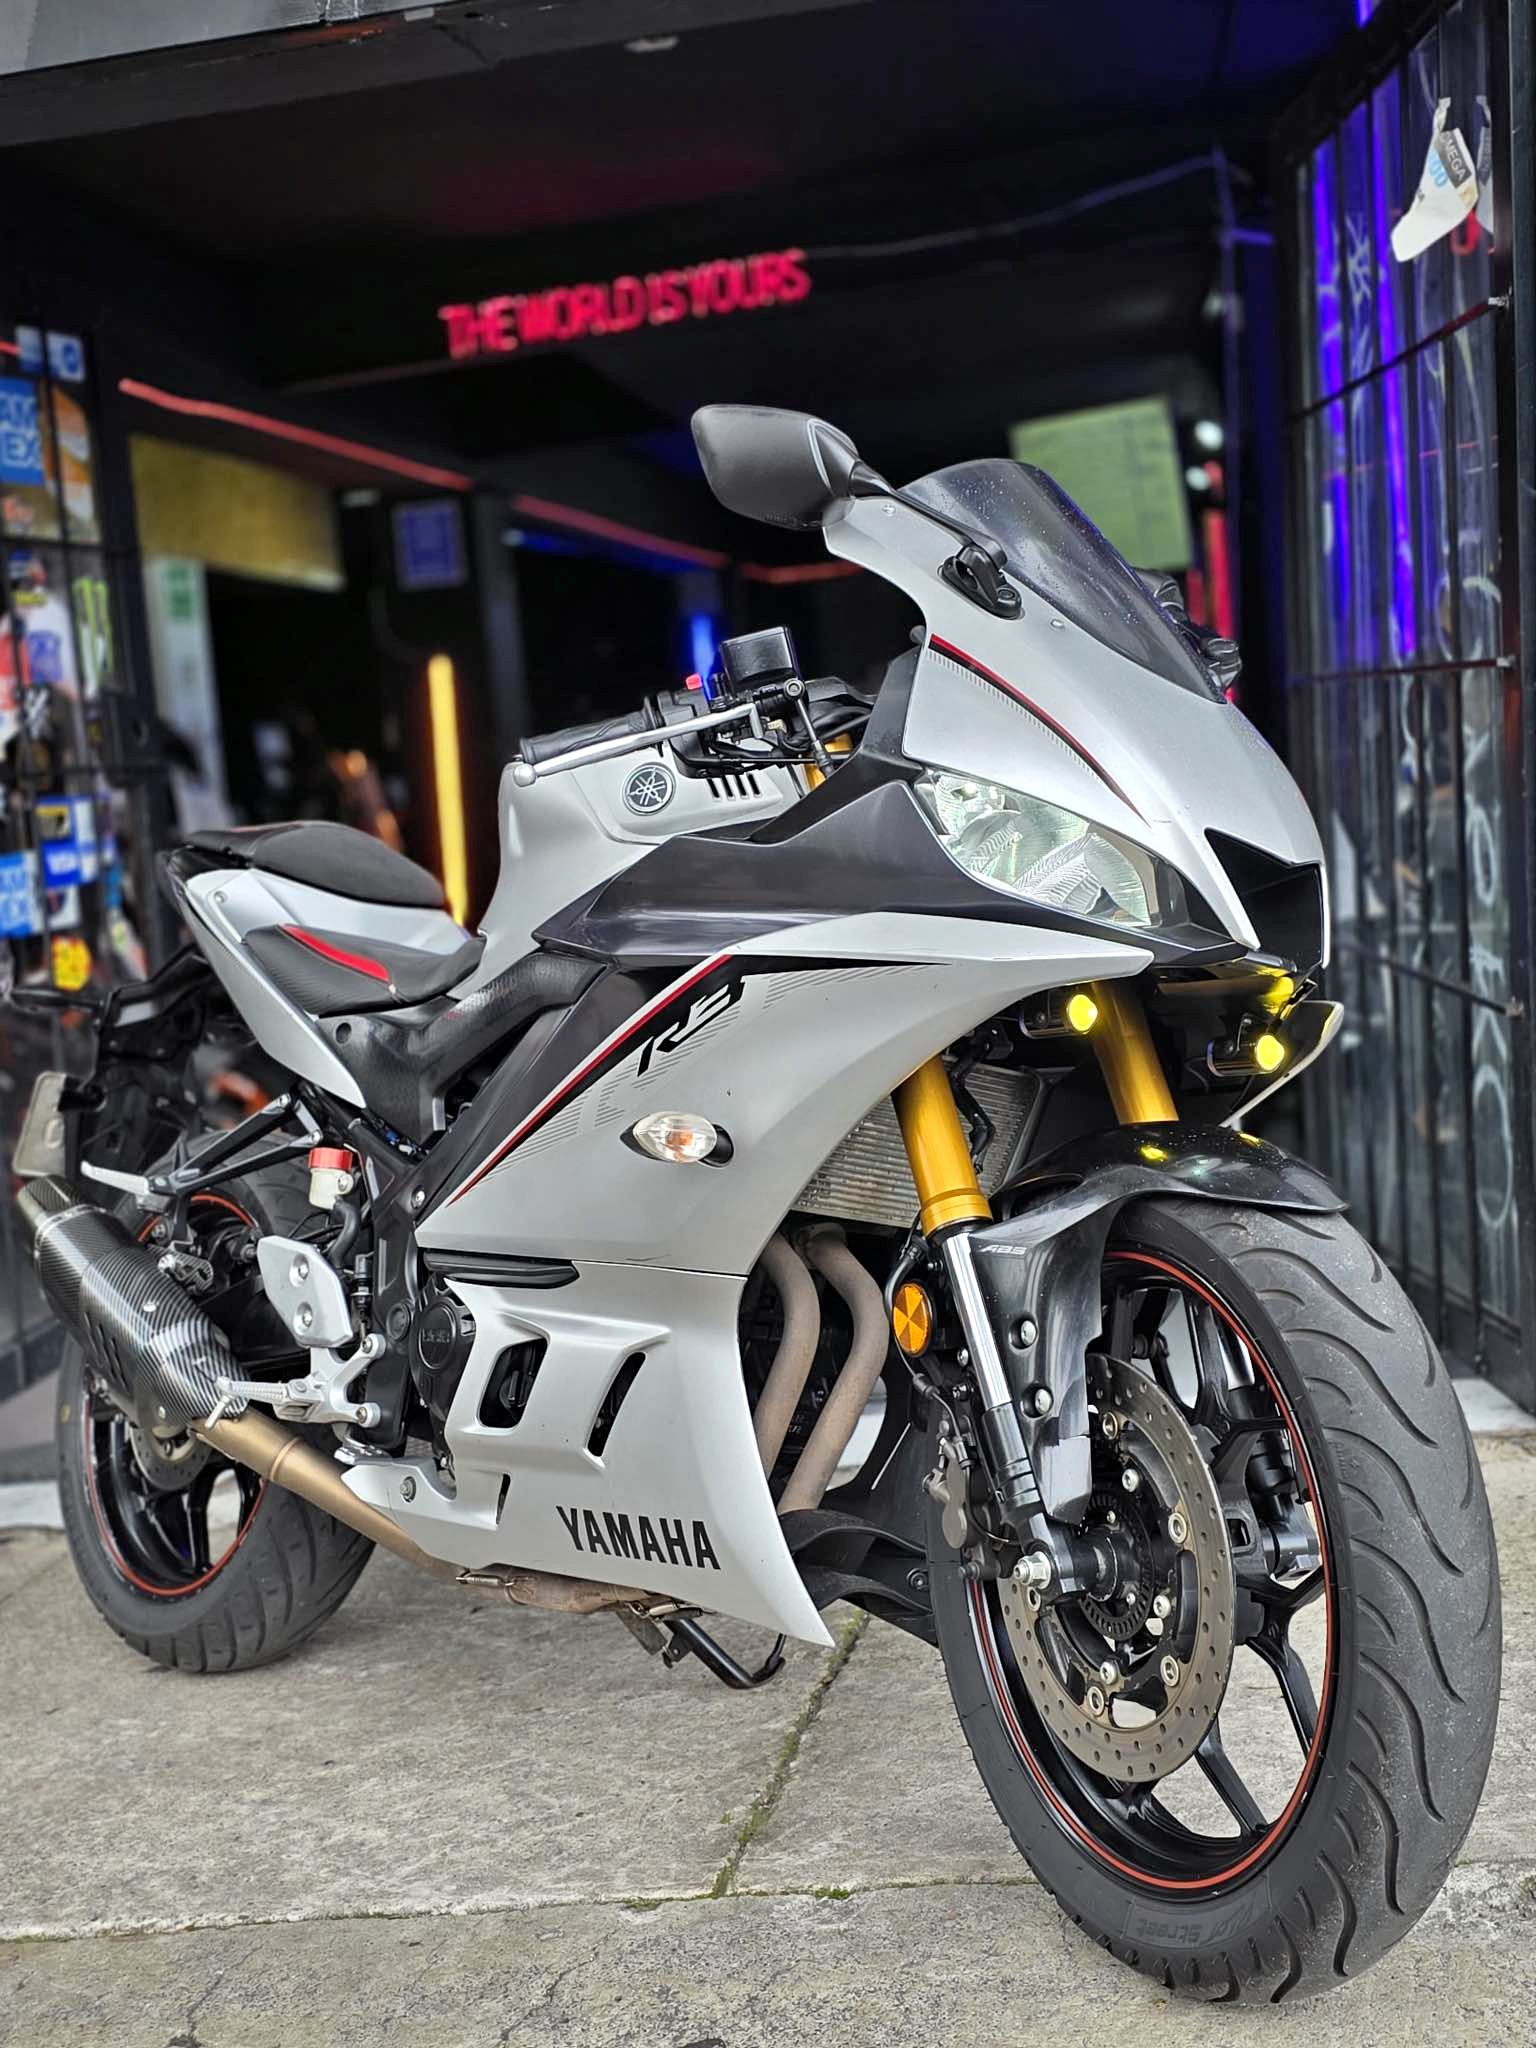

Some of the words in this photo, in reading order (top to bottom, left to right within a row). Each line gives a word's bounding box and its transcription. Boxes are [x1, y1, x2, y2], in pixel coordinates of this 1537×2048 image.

[438, 297, 517, 361] THE
[514, 276, 645, 341] WORLD
[646, 270, 686, 324] IS
[684, 248, 811, 318] YOURS
[637, 980, 745, 1078] R3
[980, 1244, 1027, 1255] ABS
[555, 1505, 721, 1570] YAMAHA
